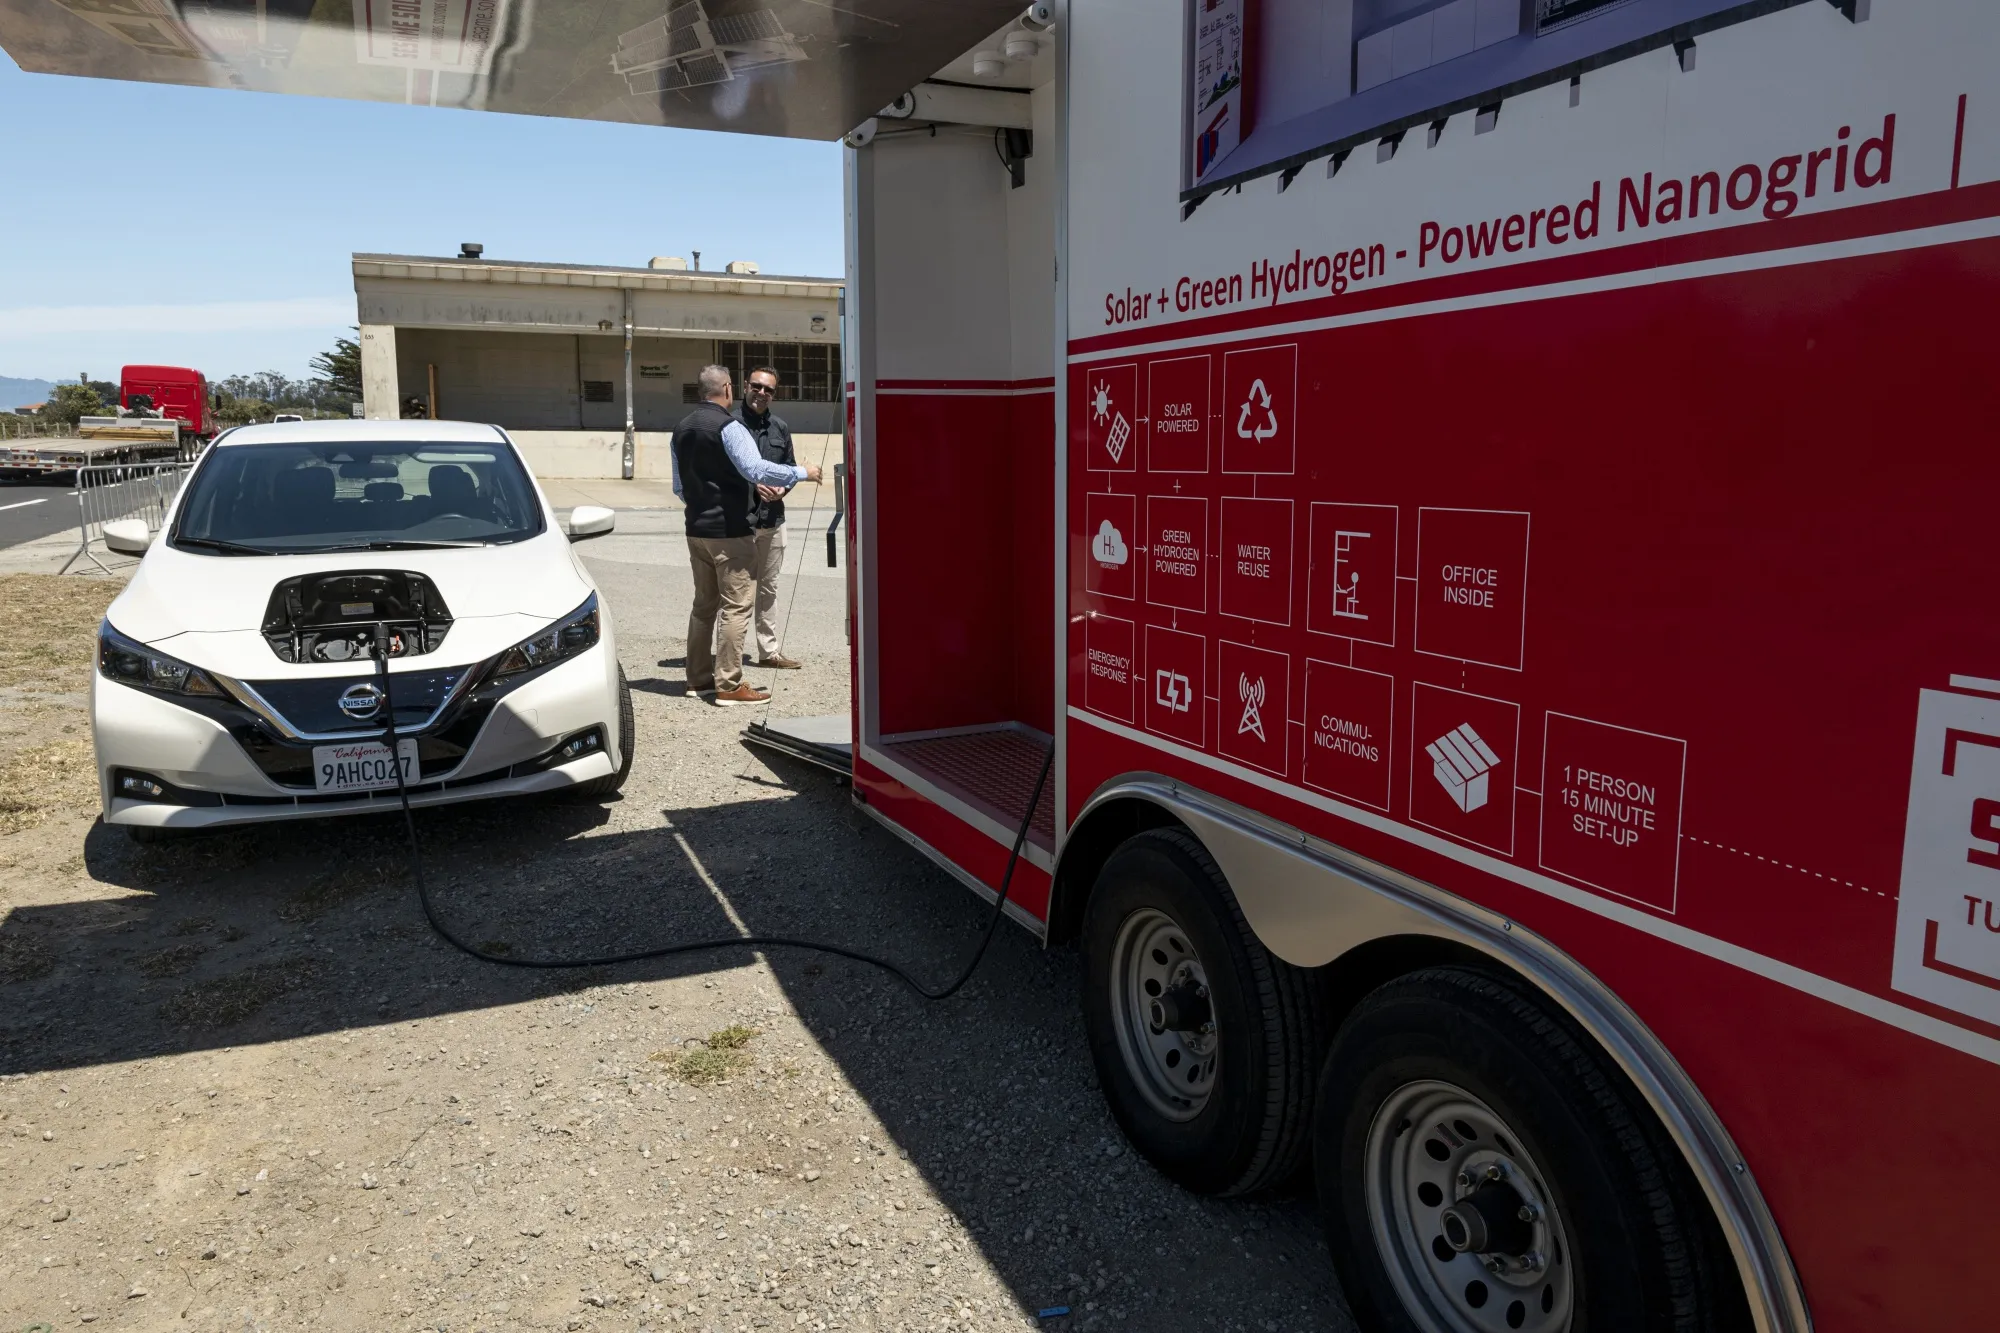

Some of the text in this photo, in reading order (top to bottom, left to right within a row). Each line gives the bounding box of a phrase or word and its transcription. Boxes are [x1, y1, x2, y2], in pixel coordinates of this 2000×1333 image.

[1105, 287, 1151, 326] Solar
[1157, 288, 1169, 313] +
[1175, 273, 1242, 313] Green
[1251, 242, 1386, 306] Hydrogen
[1419, 180, 1600, 268] Powered
[1617, 113, 1896, 233] Nanogrid
[1164, 403, 1192, 417] SOLAR
[1157, 419, 1199, 433] POWERED
[1162, 529, 1191, 544] GREEN
[1153, 545, 1200, 561] HYDROGEN
[1237, 543, 1271, 561] WATER
[1155, 560, 1197, 577] POWERED
[1237, 561, 1270, 578] REUSE
[1441, 564, 1498, 587] OFFICE
[1443, 585, 1494, 608] INSIDE
[1088, 648, 1130, 670] EMERGENCY
[1090, 663, 1127, 684] RESPONSE
[342, 698, 380, 707] NISSAN
[1320, 714, 1373, 741] COMMU-
[335, 746, 393, 760] California
[1314, 730, 1379, 763] NICATIONS
[322, 756, 411, 786] 9AHC027
[1563, 765, 1656, 806] 1 PERSON
[1560, 787, 1656, 831] 15 MINUTE
[1572, 813, 1639, 849] SET-UP
